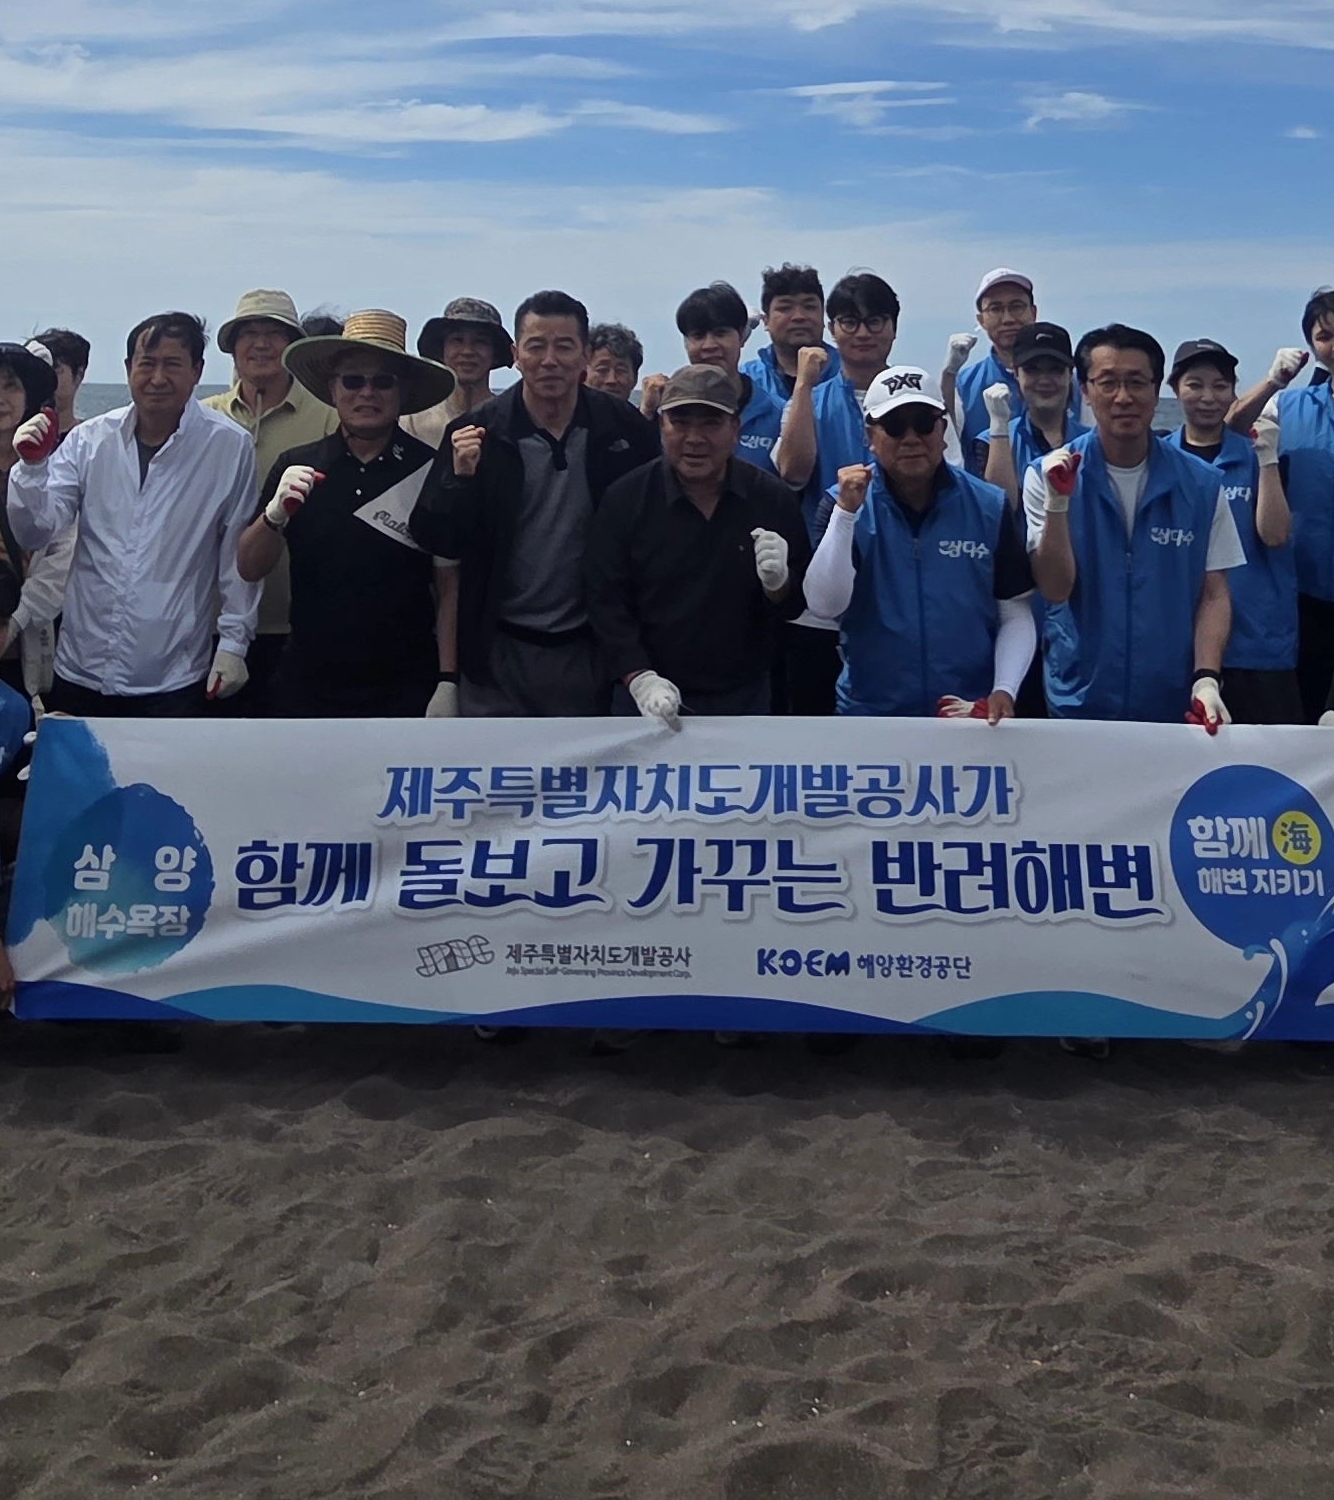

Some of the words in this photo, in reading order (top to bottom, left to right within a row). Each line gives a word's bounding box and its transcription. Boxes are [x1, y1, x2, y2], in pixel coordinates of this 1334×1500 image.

[740, 435, 773, 451] 삼다
[1224, 486, 1252, 502] 삼다
[939, 540, 990, 559] 삼다수
[1151, 527, 1195, 547] 삼다수
[376, 763, 1014, 820] 제주특별자치도개발공사가
[1187, 816, 1269, 860] 함께
[1280, 821, 1313, 855] 海
[235, 840, 372, 910] 함께
[398, 839, 607, 909] 돌보고
[628, 838, 843, 911] 가꾸는
[871, 840, 1165, 918] 반려해변
[1197, 867, 1248, 895] 해변
[1250, 868, 1325, 897] 지키기
[66, 902, 191, 940] 해수욕장
[506, 944, 691, 968] 제주특별자치도개발공사
[757, 948, 850, 976] KOEM
[856, 953, 972, 980] 해양환경공단
